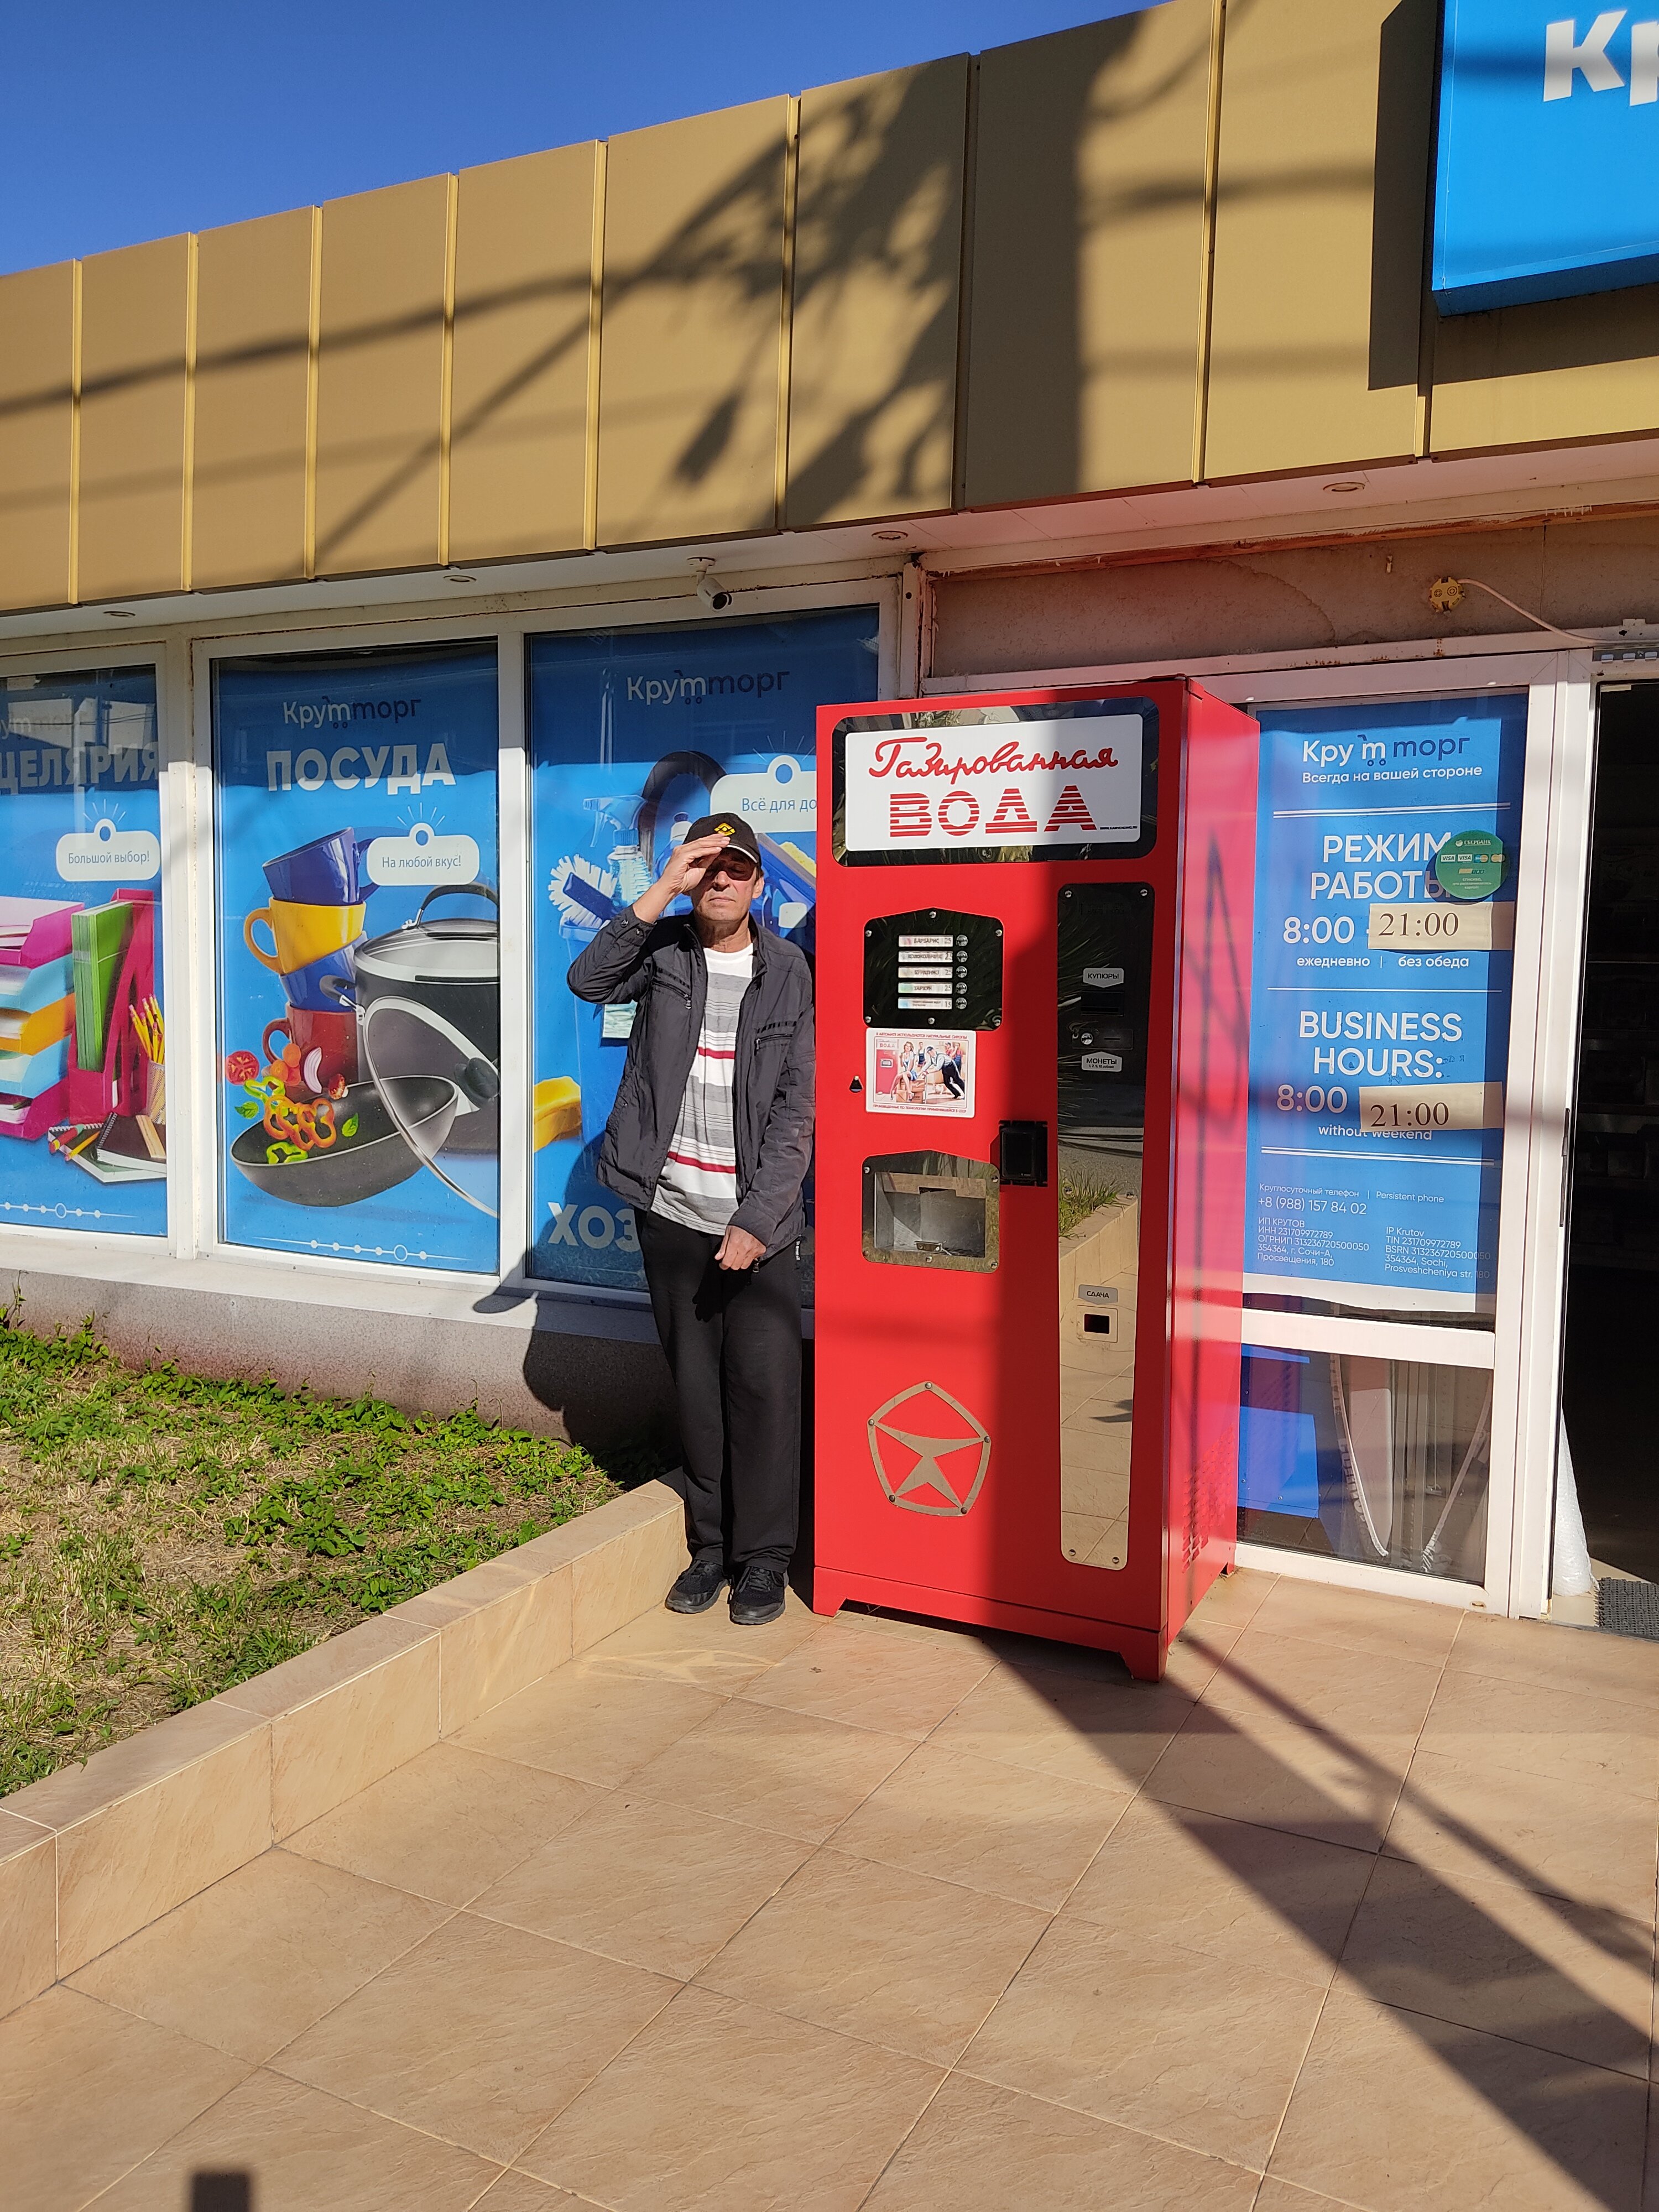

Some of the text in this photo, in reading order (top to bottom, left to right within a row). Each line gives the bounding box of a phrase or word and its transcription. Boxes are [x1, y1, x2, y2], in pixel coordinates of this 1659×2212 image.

[868, 736, 1118, 785] Газированная
[267, 743, 456, 795] ПОСУДА
[1302, 765, 1483, 784] Всегда на вашей стороне
[742, 796, 766, 810] Всё
[770, 799, 795, 813] для
[890, 785, 1097, 837] ВОДА
[1323, 833, 1452, 863] РЕЖИМ
[68, 851, 150, 867] Большой выбор!
[382, 856, 462, 870] На любой вкус!
[1311, 870, 1452, 900] РАБОТЫ
[1283, 916, 1354, 944] 8:00
[1379, 912, 1459, 937] 21:00
[1297, 956, 1469, 969] ежедневно без обеда
[1300, 1011, 1463, 1042] BUSINESS
[1313, 1047, 1443, 1078] HOURS:
[1277, 1084, 1348, 1114] 8:00
[1370, 1102, 1449, 1127] 21:00
[1260, 1183, 1359, 1197] Круглосуточный телефон
[1376, 1191, 1444, 1203] Persistent phone
[1258, 1196, 1367, 1215] +8 (988) 157 84 02
[1272, 1218, 1305, 1228] КРУТОВ
[1278, 1227, 1333, 1239] 231709972789
[1396, 1228, 1425, 1237] Krutov
[1258, 1235, 1369, 1251] ОГРНИП 313236720500050
[1258, 1244, 1288, 1255] 354364,
[1386, 1236, 1461, 1249] TIN 231709972789
[1258, 1253, 1334, 1266] Просвещения, 180
[1385, 1245, 1490, 1260] BSRN 313236720500050
[1385, 1254, 1448, 1268] 354364, Sochi,
[1385, 1264, 1458, 1278] Prosveshcheniya
